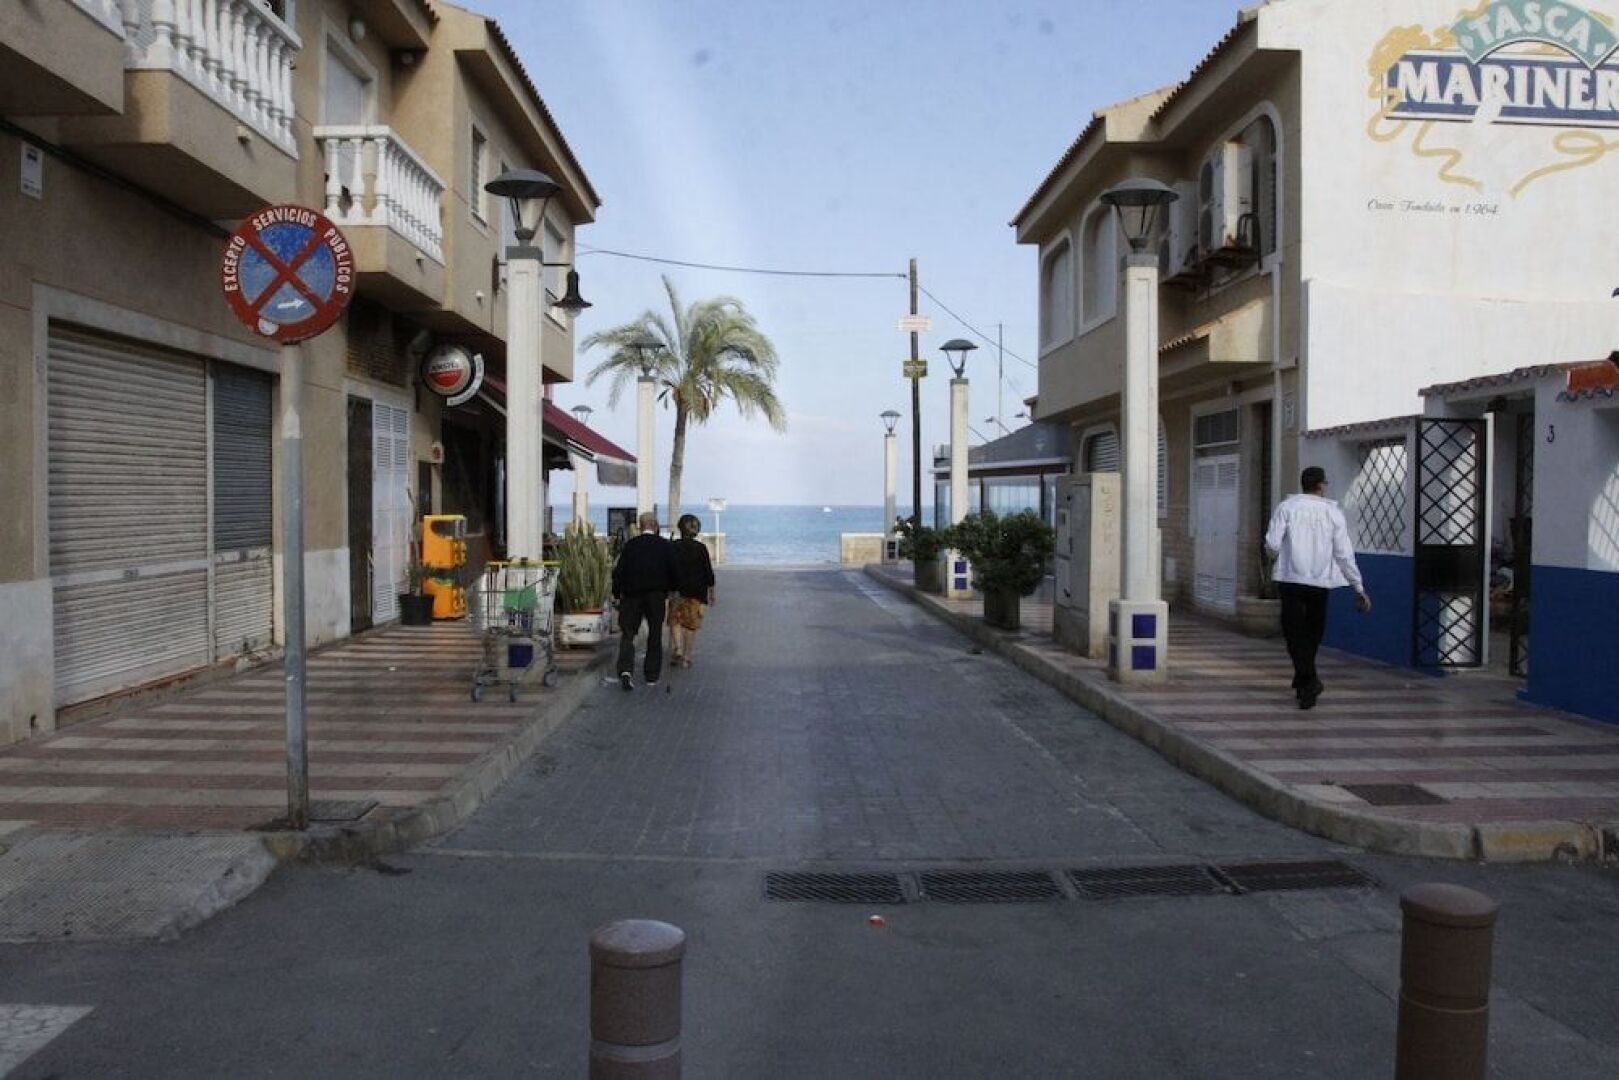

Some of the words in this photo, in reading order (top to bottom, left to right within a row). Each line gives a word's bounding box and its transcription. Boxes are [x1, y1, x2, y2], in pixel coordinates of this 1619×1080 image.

[1467, 1, 1591, 51] TASCA
[222, 235, 246, 292] EXCEPTO
[252, 208, 317, 231] SERVICIOS
[323, 227, 351, 294] PUBLICOS
[1546, 424, 1555, 443] 3
